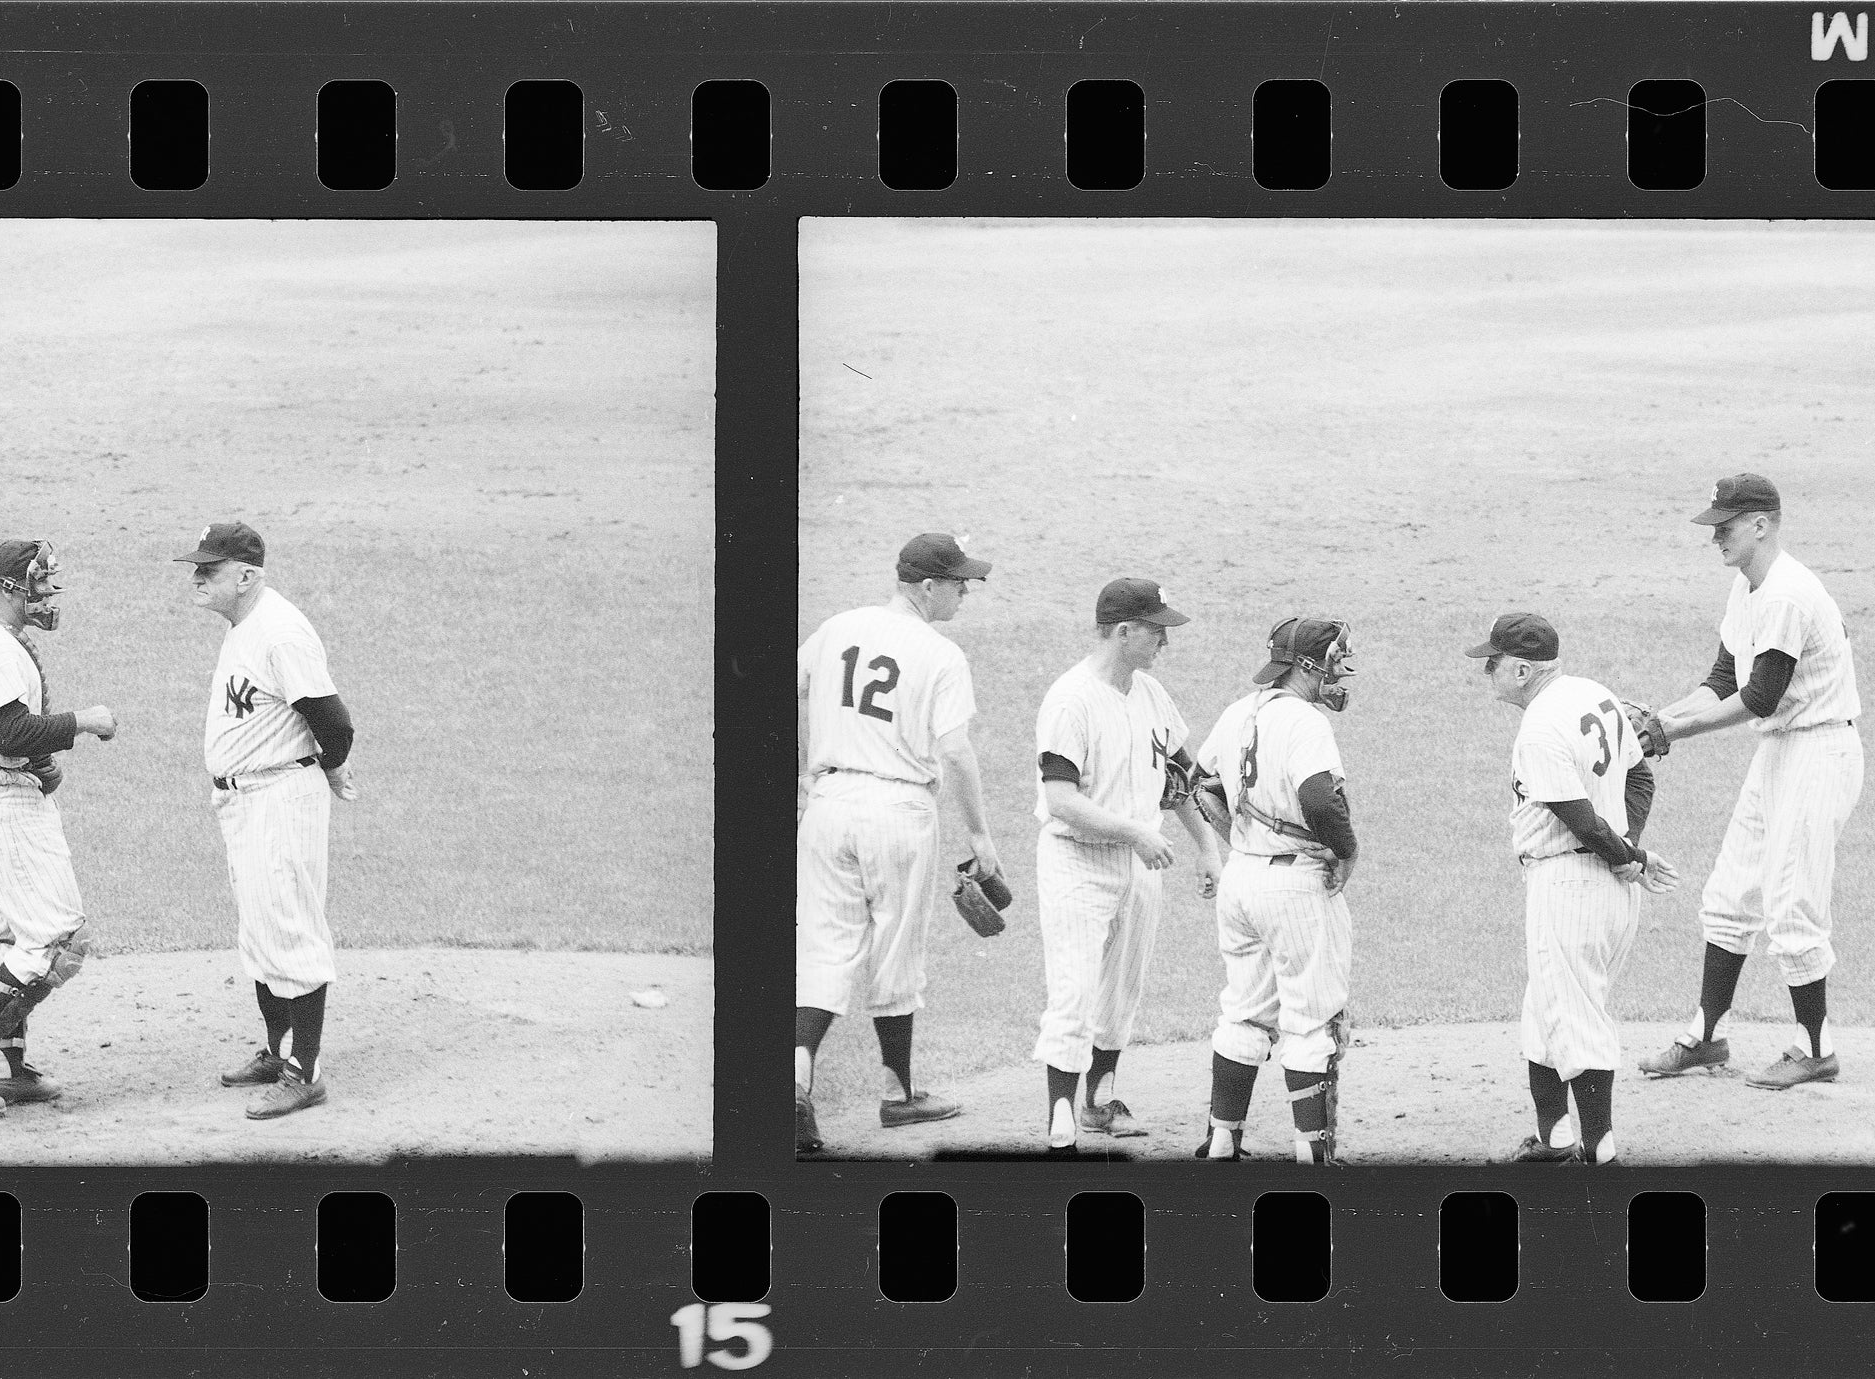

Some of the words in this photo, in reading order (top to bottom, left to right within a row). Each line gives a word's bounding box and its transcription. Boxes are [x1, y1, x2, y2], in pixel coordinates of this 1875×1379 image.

[841, 645, 901, 723] 12
[1580, 698, 1626, 778] 37
[671, 1301, 772, 1370] 15
